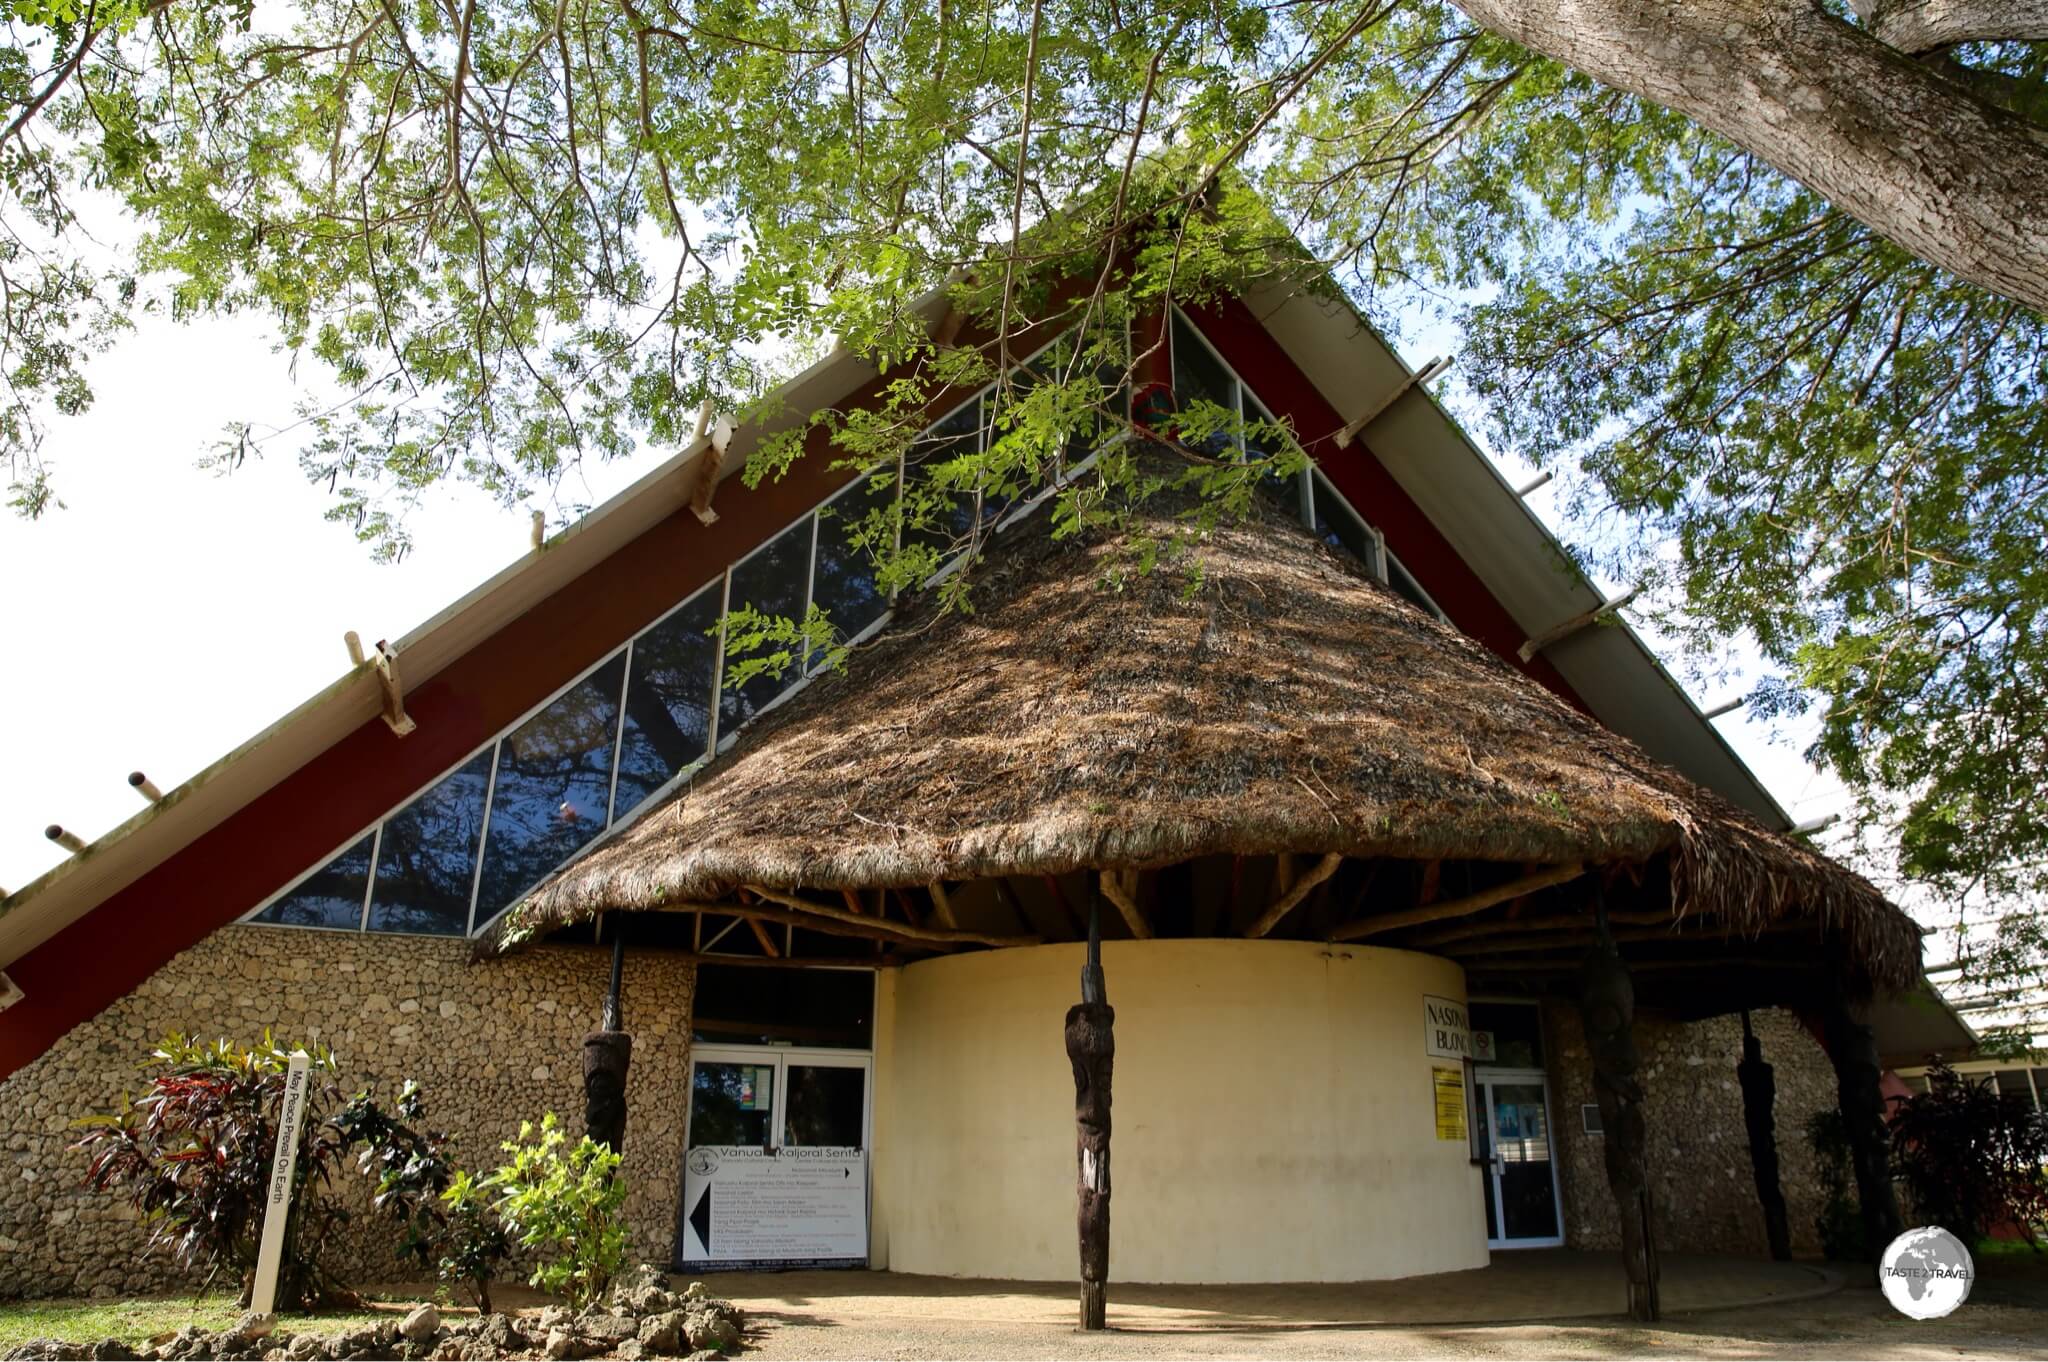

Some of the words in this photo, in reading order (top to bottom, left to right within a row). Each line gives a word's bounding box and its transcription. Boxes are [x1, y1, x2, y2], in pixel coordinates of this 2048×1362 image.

[290, 1070, 303, 1092] May
[285, 1093, 299, 1123] Peace
[280, 1125, 294, 1157] Prevail
[721, 1147, 771, 1157] Vanua
[779, 1148, 822, 1159] Kaljoral
[826, 1149, 861, 1158] Senta
[278, 1159, 289, 1174] On
[273, 1176, 286, 1204] Earth
